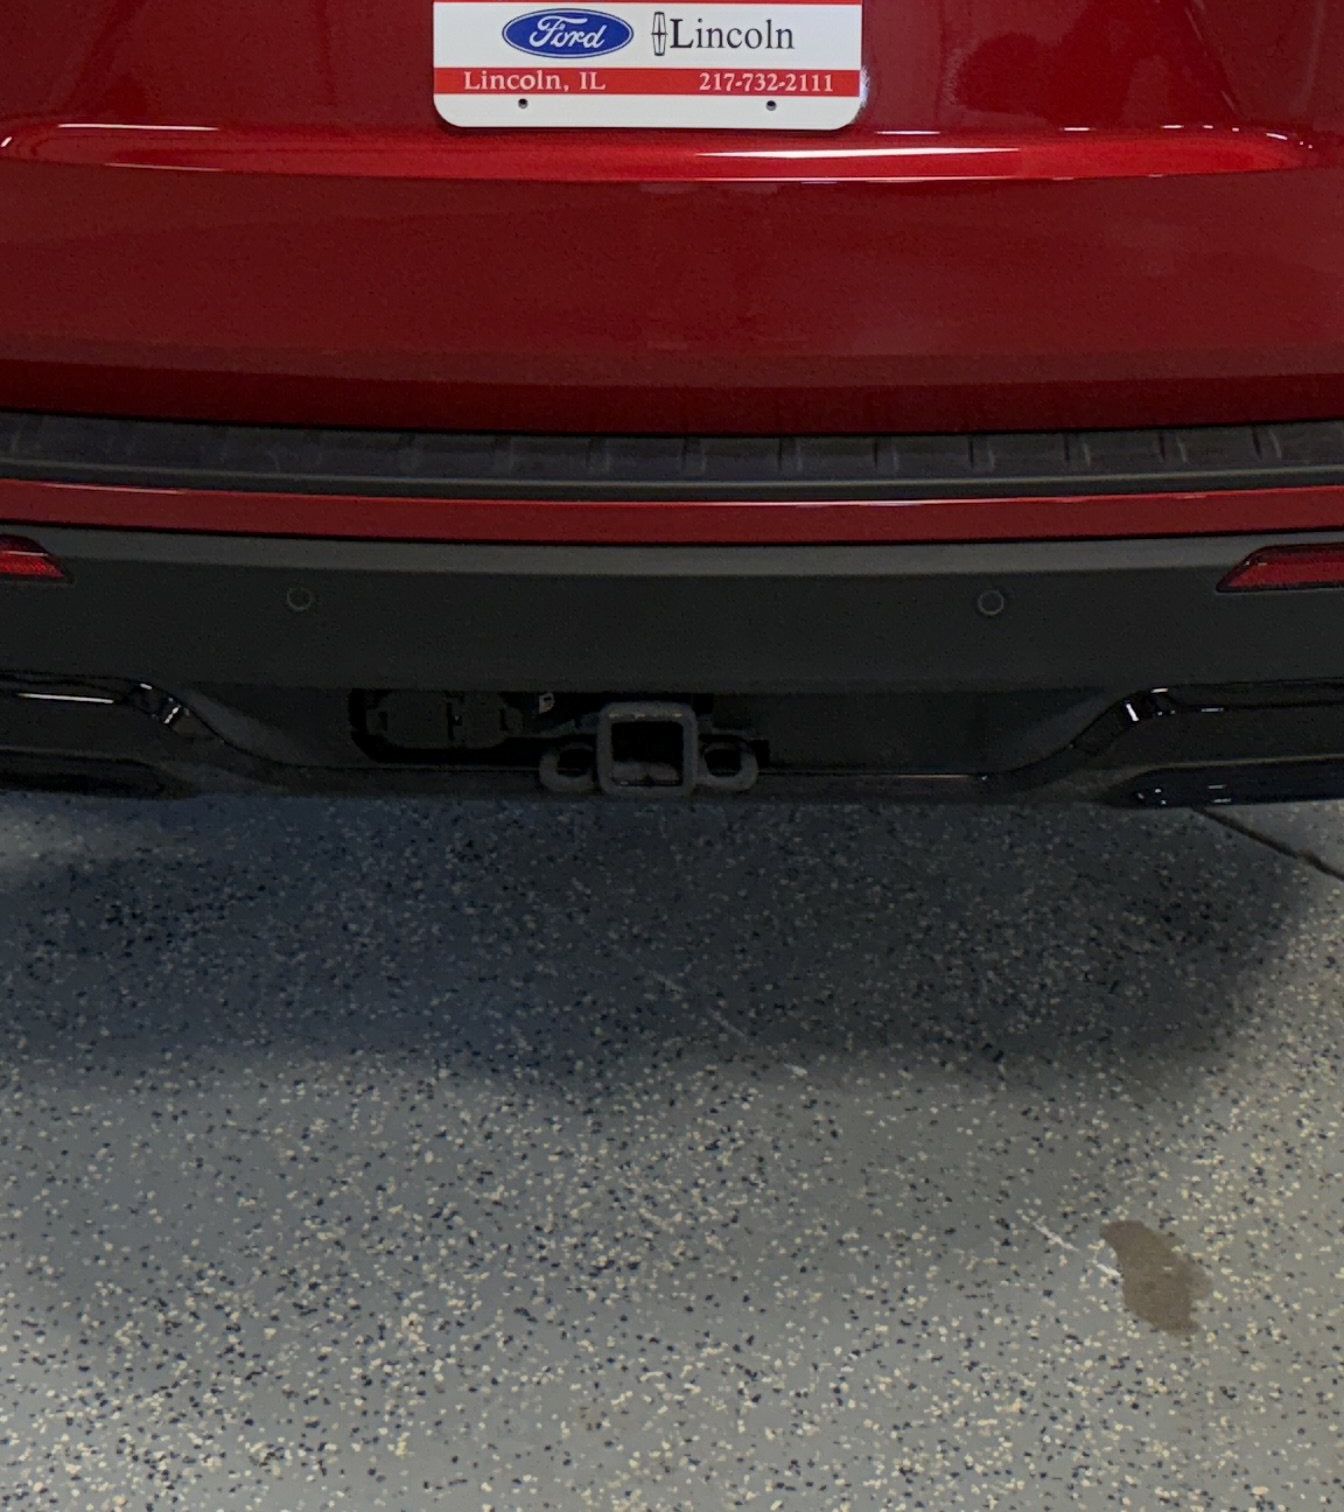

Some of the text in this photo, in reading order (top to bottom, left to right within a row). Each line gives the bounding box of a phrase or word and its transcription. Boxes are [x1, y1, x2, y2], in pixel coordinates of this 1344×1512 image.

[528, 15, 607, 49] Ford
[669, 17, 795, 50] Lincoln
[463, 70, 606, 93] Lincoln, IL
[699, 73, 834, 93] 217-732-2111
